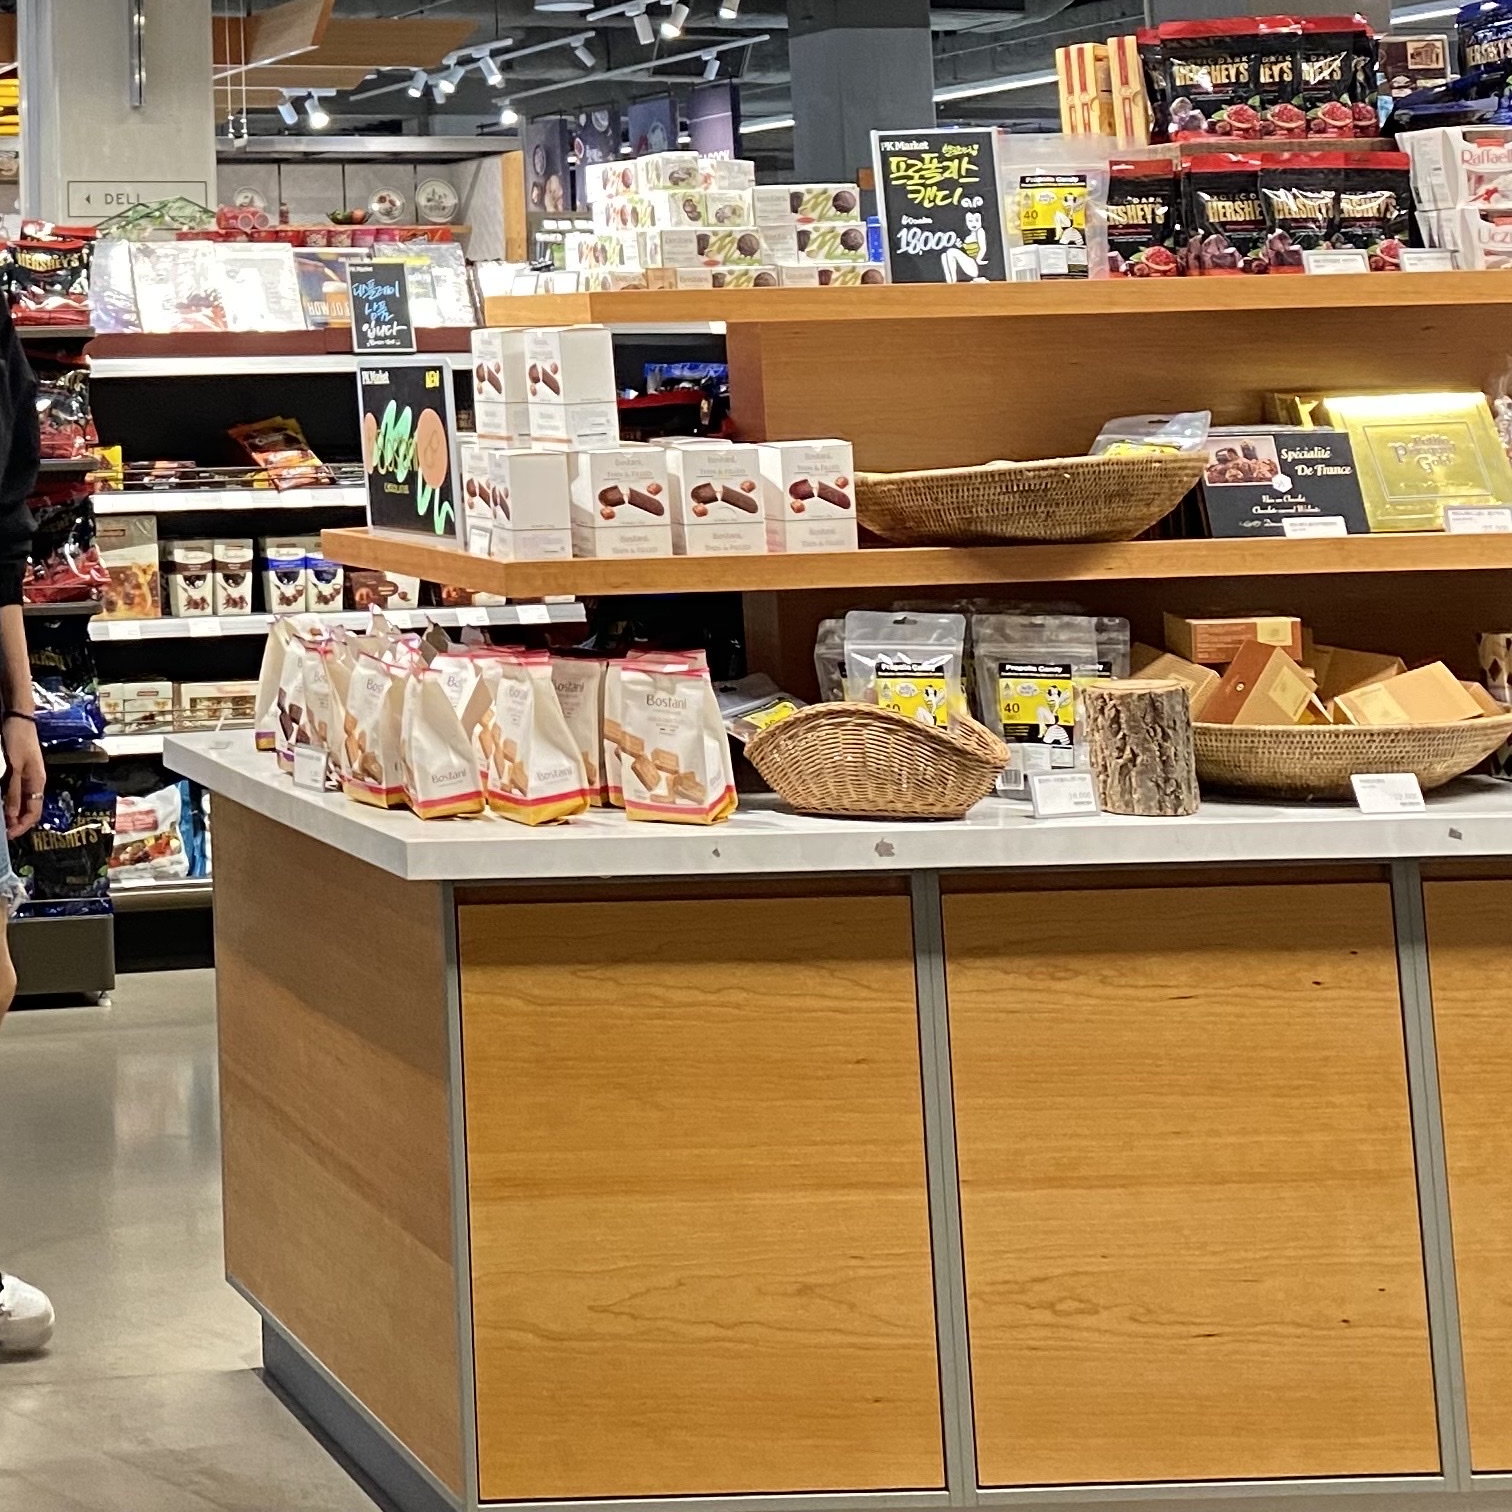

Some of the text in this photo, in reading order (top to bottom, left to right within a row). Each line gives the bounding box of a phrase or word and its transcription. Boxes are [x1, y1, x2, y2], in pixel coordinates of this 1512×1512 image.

[895, 141, 930, 151] Market
[1023, 210, 1039, 220] 40
[16, 250, 81, 272] HERSHEY'S
[1281, 445, 1332, 461] Spécialité
[1295, 463, 1353, 476] De France
[1005, 664, 1063, 675] Propolis Candy
[645, 693, 687, 710] Bostani
[1004, 702, 1020, 714] 40
[34, 826, 99, 851] HERSHEY'S
